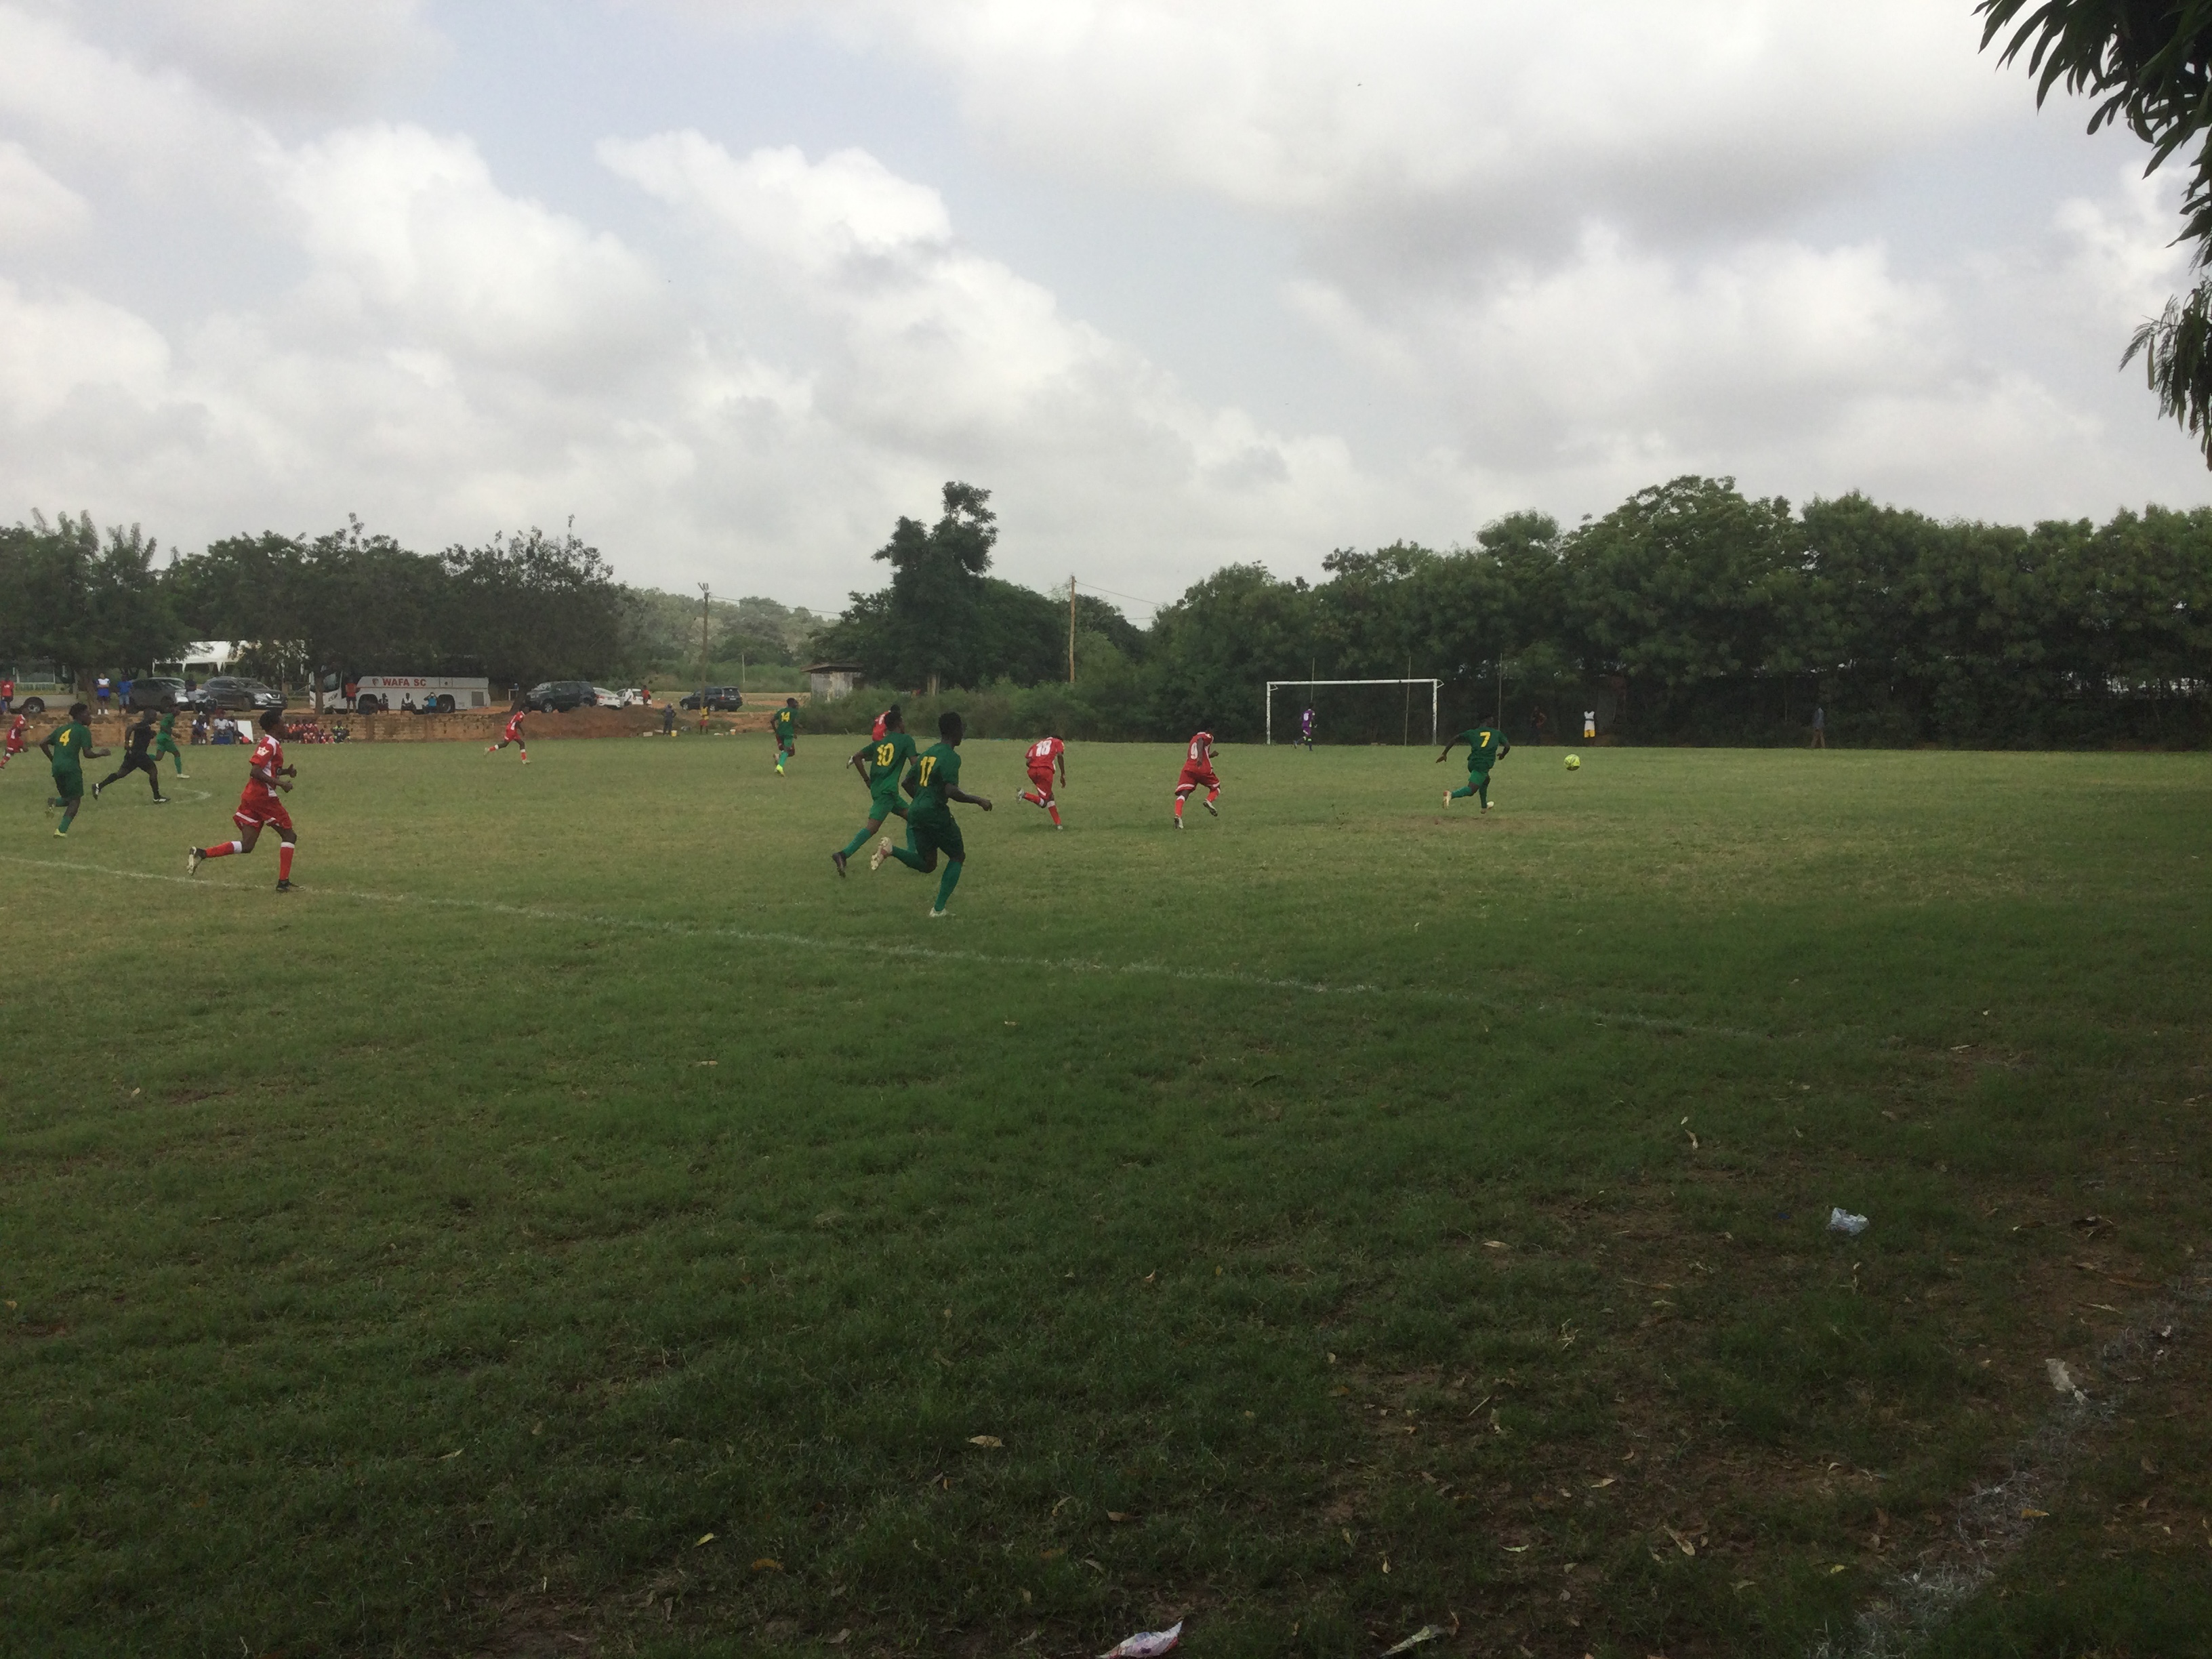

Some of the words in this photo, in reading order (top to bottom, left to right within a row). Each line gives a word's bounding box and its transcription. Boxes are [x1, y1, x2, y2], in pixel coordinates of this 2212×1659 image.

[382, 678, 410, 687] WAFA
[414, 678, 426, 687] SC
[781, 712, 790, 722] 14
[60, 729, 72, 746] 4
[1480, 732, 1490, 747] 7
[1036, 740, 1052, 756] 18
[920, 756, 937, 787] 17
